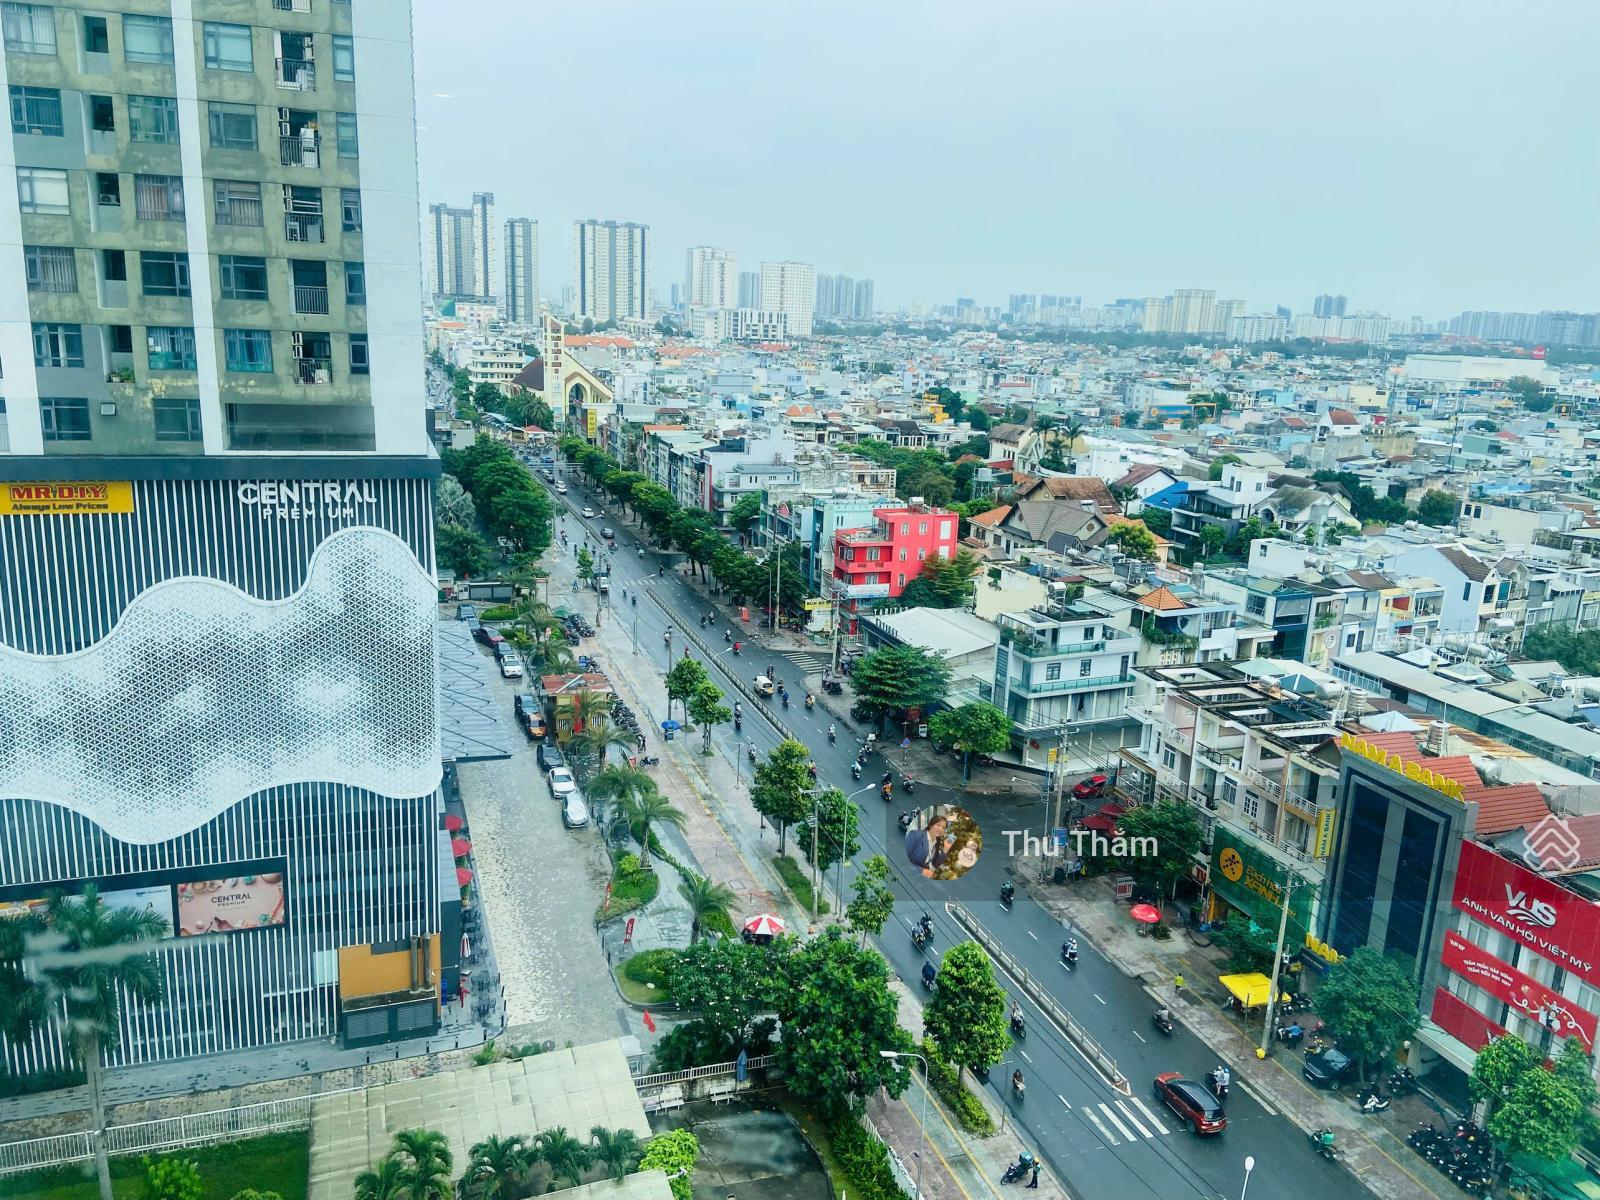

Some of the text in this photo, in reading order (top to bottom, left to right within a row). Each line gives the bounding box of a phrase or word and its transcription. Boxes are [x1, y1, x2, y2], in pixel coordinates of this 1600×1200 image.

[237, 482, 377, 504] CENTRAL
[12, 503, 50, 511] Always
[76, 502, 108, 510] Prices
[263, 508, 354, 519] PREMIUM
[1341, 732, 1388, 767] NAM
[1405, 760, 1466, 803] BANK
[1324, 813, 1332, 832] BANK
[211, 893, 252, 904] CENTRAL
[1505, 882, 1558, 926] VUS
[1462, 897, 1489, 916] ANH
[1516, 925, 1538, 943] HỘI
[1539, 938, 1569, 960] VIỆT
